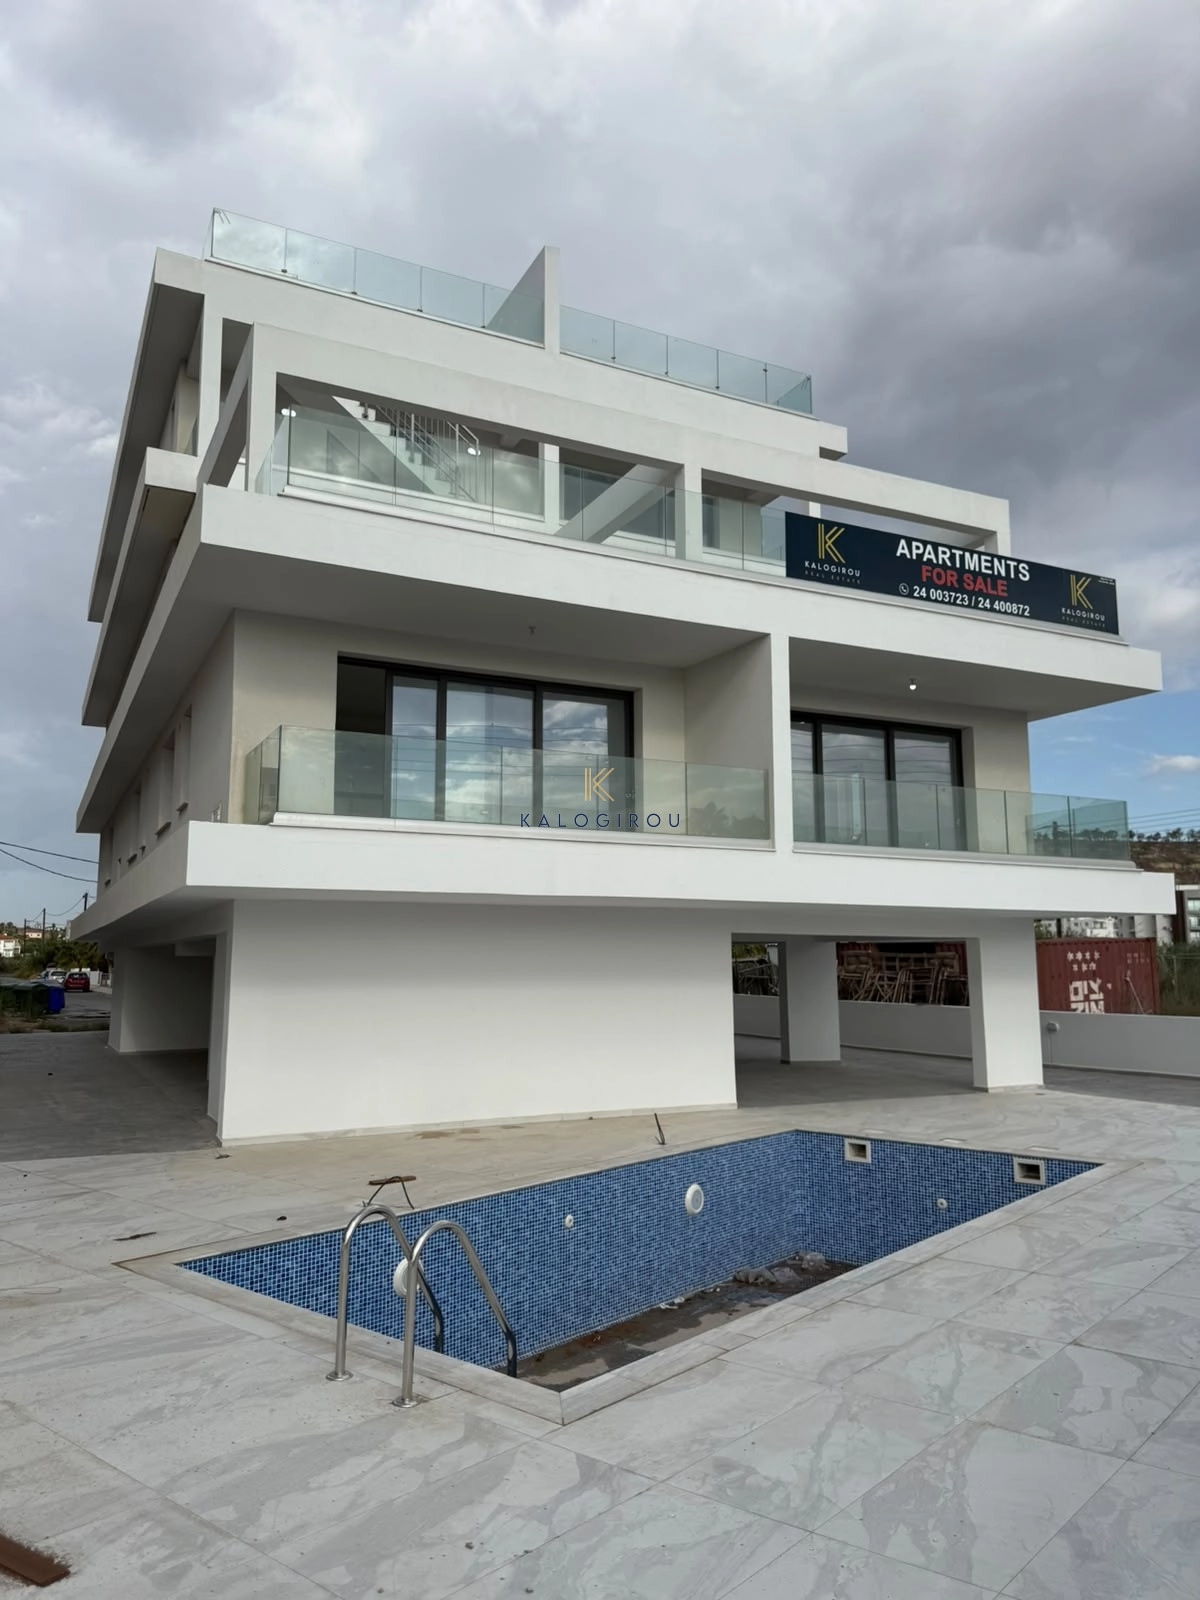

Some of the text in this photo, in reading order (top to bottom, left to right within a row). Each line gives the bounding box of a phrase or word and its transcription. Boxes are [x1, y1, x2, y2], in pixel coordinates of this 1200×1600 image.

[804, 560, 861, 577] KALOGIROU
[896, 538, 1030, 582] APARTMENTS
[921, 565, 1008, 597] FOR SALE
[913, 585, 927, 598] 24
[929, 588, 969, 606] 003723
[978, 597, 990, 609] 24
[993, 599, 1030, 616] 400872
[1061, 607, 1105, 622] KALOGIROU
